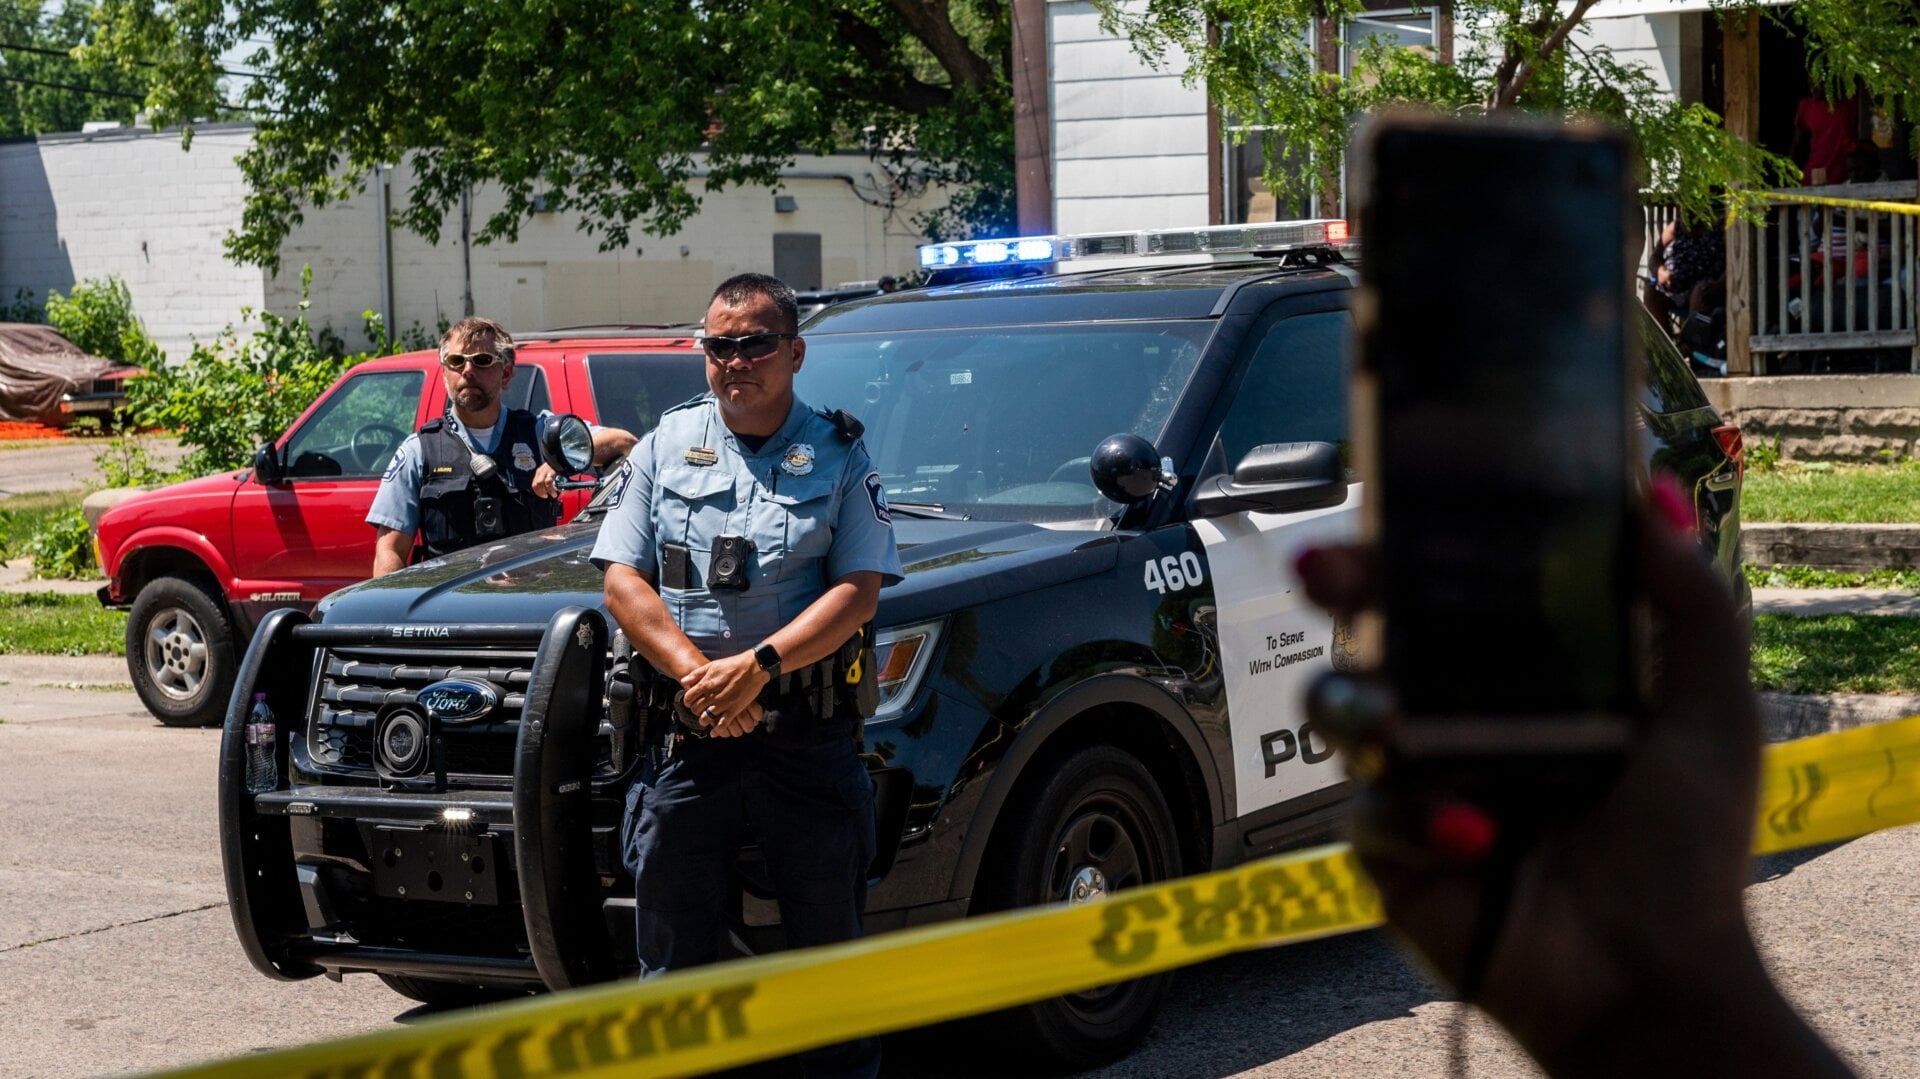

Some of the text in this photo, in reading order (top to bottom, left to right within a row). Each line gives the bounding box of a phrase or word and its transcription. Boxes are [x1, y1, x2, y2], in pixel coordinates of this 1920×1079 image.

[1143, 551, 1203, 595] 460
[261, 592, 300, 601] BLAZER
[392, 626, 450, 638] SETINA
[1266, 631, 1305, 651] TO SERVE
[1249, 658, 1272, 676] WITH
[1274, 645, 1324, 669] COMPASSION
[427, 691, 471, 711] Ford
[1260, 721, 1337, 779] PO
